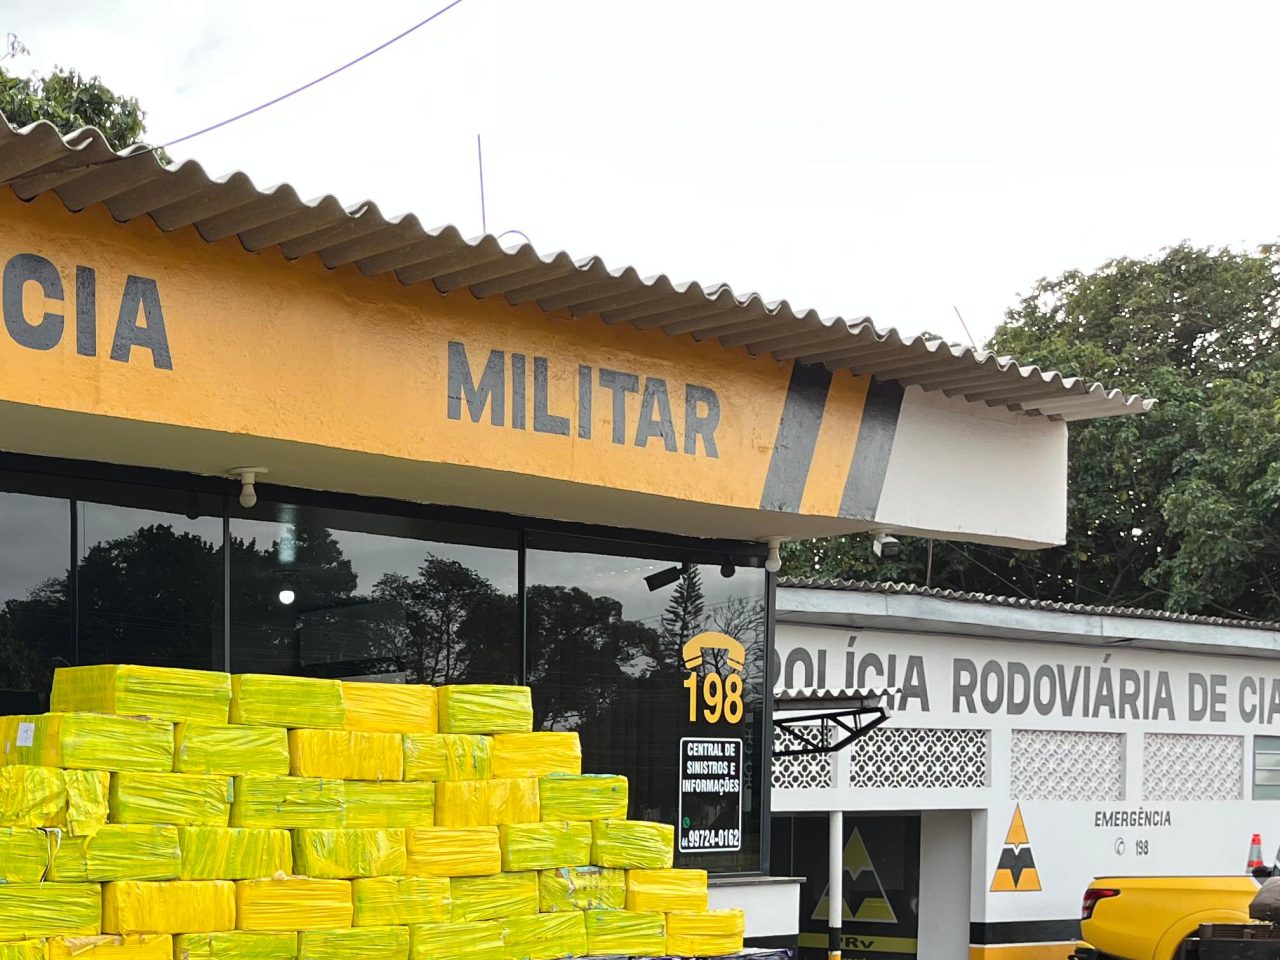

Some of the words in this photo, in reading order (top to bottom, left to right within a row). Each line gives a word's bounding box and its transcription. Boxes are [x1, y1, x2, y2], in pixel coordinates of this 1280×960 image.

[448, 341, 721, 459] MILITAR
[952, 653, 1176, 721] RODOVIÁRIA
[1188, 672, 1227, 722] DE
[683, 671, 744, 724] 198
[687, 743, 723, 756] CENTRAL
[724, 743, 736, 756] DE
[686, 761, 728, 775] SINISTROS
[730, 762, 736, 775] E
[682, 777, 739, 796] INFORMAÇÕES
[1094, 806, 1171, 827] EMERGÊNCIA
[688, 829, 739, 847] 99724-0162
[1136, 839, 1149, 856] 198
